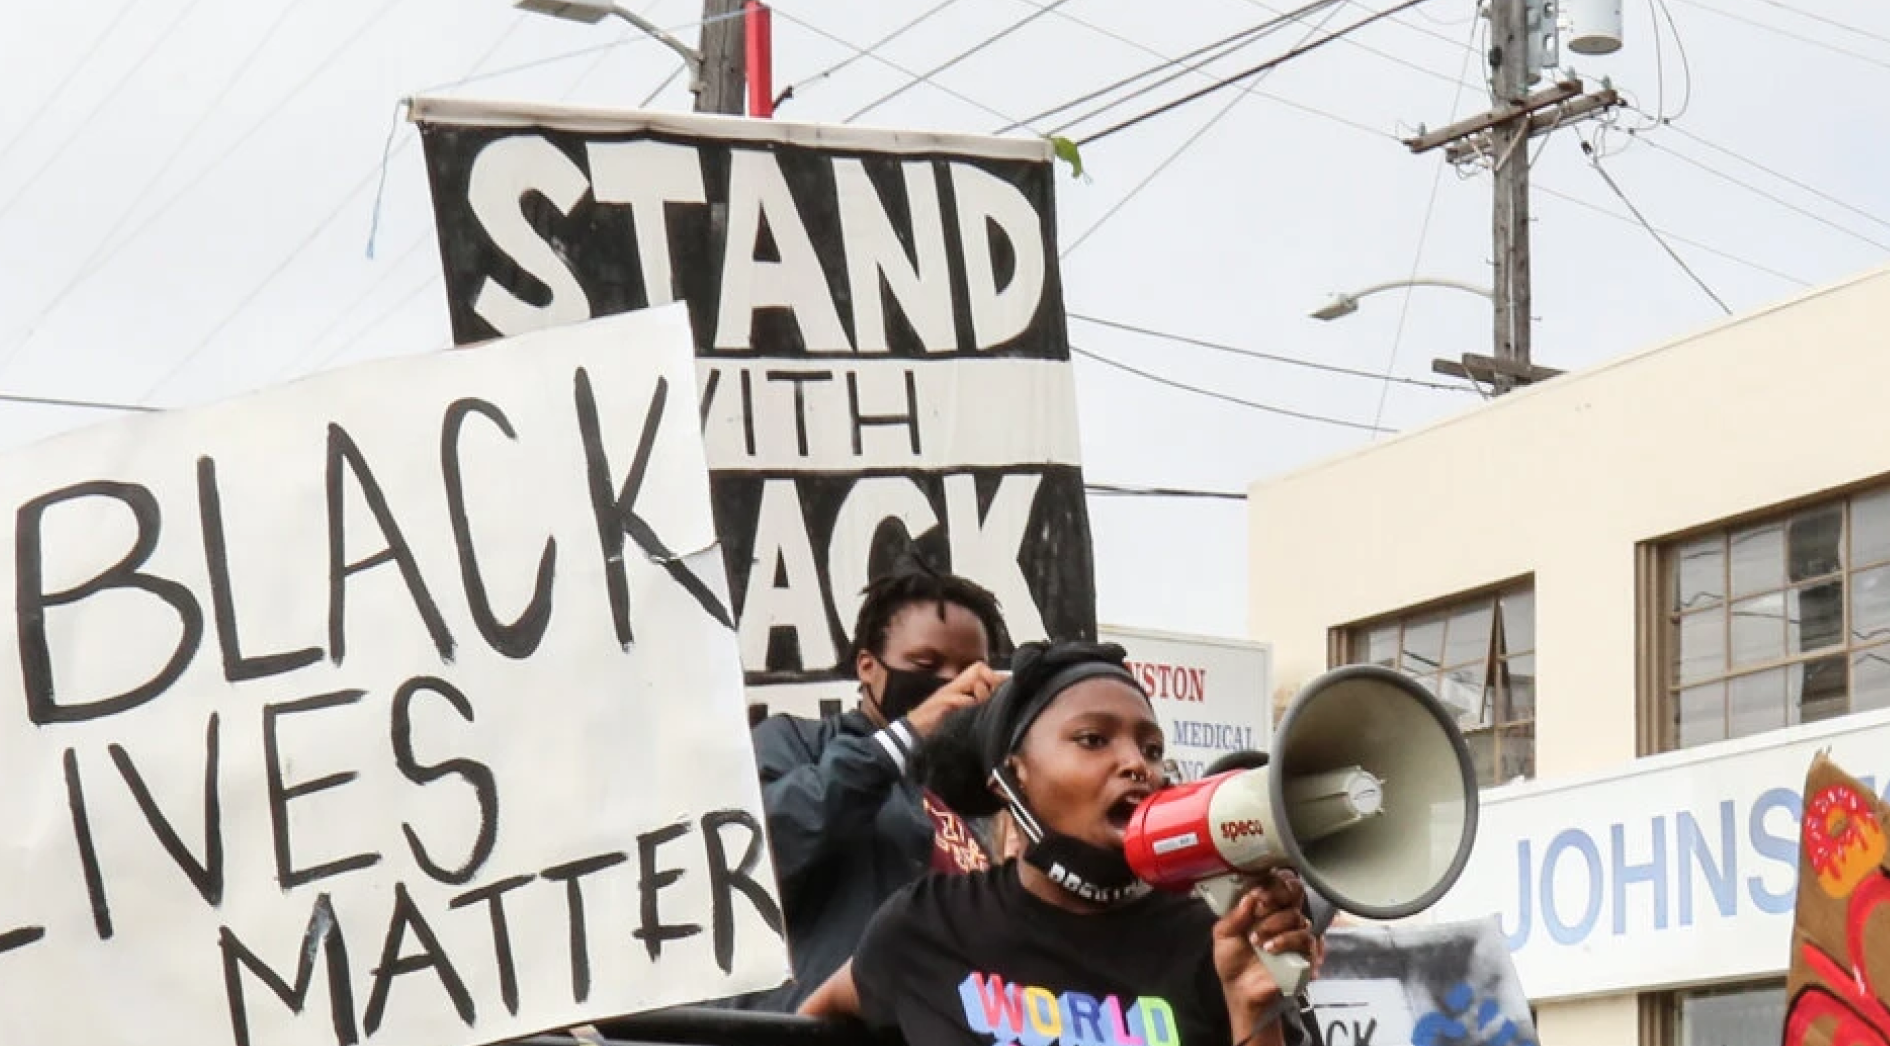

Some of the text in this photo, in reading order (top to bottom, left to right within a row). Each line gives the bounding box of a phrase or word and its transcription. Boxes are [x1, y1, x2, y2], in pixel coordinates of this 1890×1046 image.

[467, 135, 1046, 353] STAND
[15, 366, 738, 726] BLACK
[739, 474, 1053, 672] ACK
[0, 675, 498, 954] IVES
[1493, 774, 1890, 953] JOHNS
